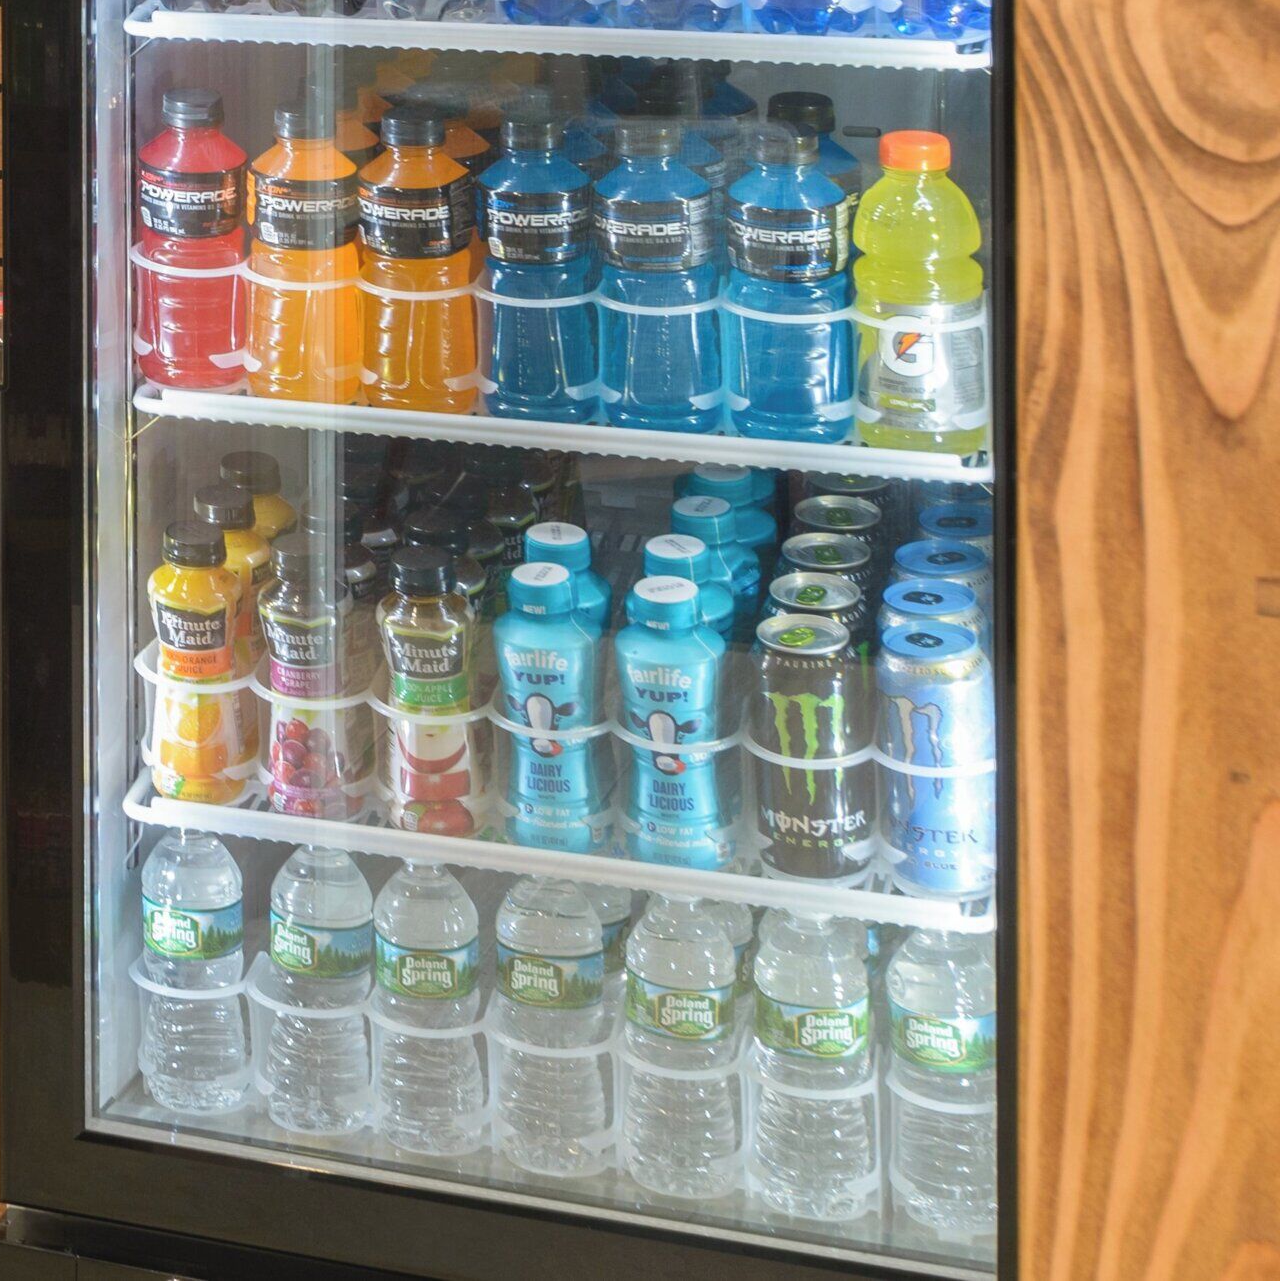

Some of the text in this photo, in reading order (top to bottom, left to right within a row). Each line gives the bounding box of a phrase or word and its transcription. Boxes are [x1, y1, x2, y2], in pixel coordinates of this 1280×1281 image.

[141, 180, 237, 204] POWERADE
[259, 194, 356, 213] POWERADE
[523, 604, 546, 614] NEW!
[160, 610, 220, 632] Minute
[168, 629, 215, 646] Maid
[266, 625, 323, 645] Minute
[274, 639, 318, 660] Maid
[396, 643, 457, 660] Minute
[181, 654, 217, 666] ORANGE
[402, 658, 450, 675] Maid
[504, 646, 568, 671] fairlife
[775, 657, 832, 669] TAURINE
[277, 668, 321, 681] CRANBERRY
[514, 672, 565, 686] YUP!
[626, 663, 692, 689] fairlife
[280, 677, 312, 690] GRAPE
[426, 684, 453, 695] APPLE
[414, 693, 443, 704] JUICE
[635, 686, 688, 703] YUP!
[530, 762, 562, 778] DAIRY
[652, 779, 685, 795] DAIRY
[761, 808, 866, 835] MONSTER
[774, 834, 856, 848] ENERGY
[277, 923, 308, 945] Poland
[274, 936, 311, 964] Spring
[405, 956, 448, 972] Poland
[514, 959, 554, 977] Poland
[402, 967, 451, 990] Spring
[511, 971, 558, 997] Spring
[667, 995, 709, 1011] Poland
[661, 1006, 713, 1028] Spring
[806, 1014, 849, 1028] Poland
[801, 1024, 853, 1047] Spring
[908, 1017, 953, 1039] Poland
[906, 1032, 960, 1058] Spring
